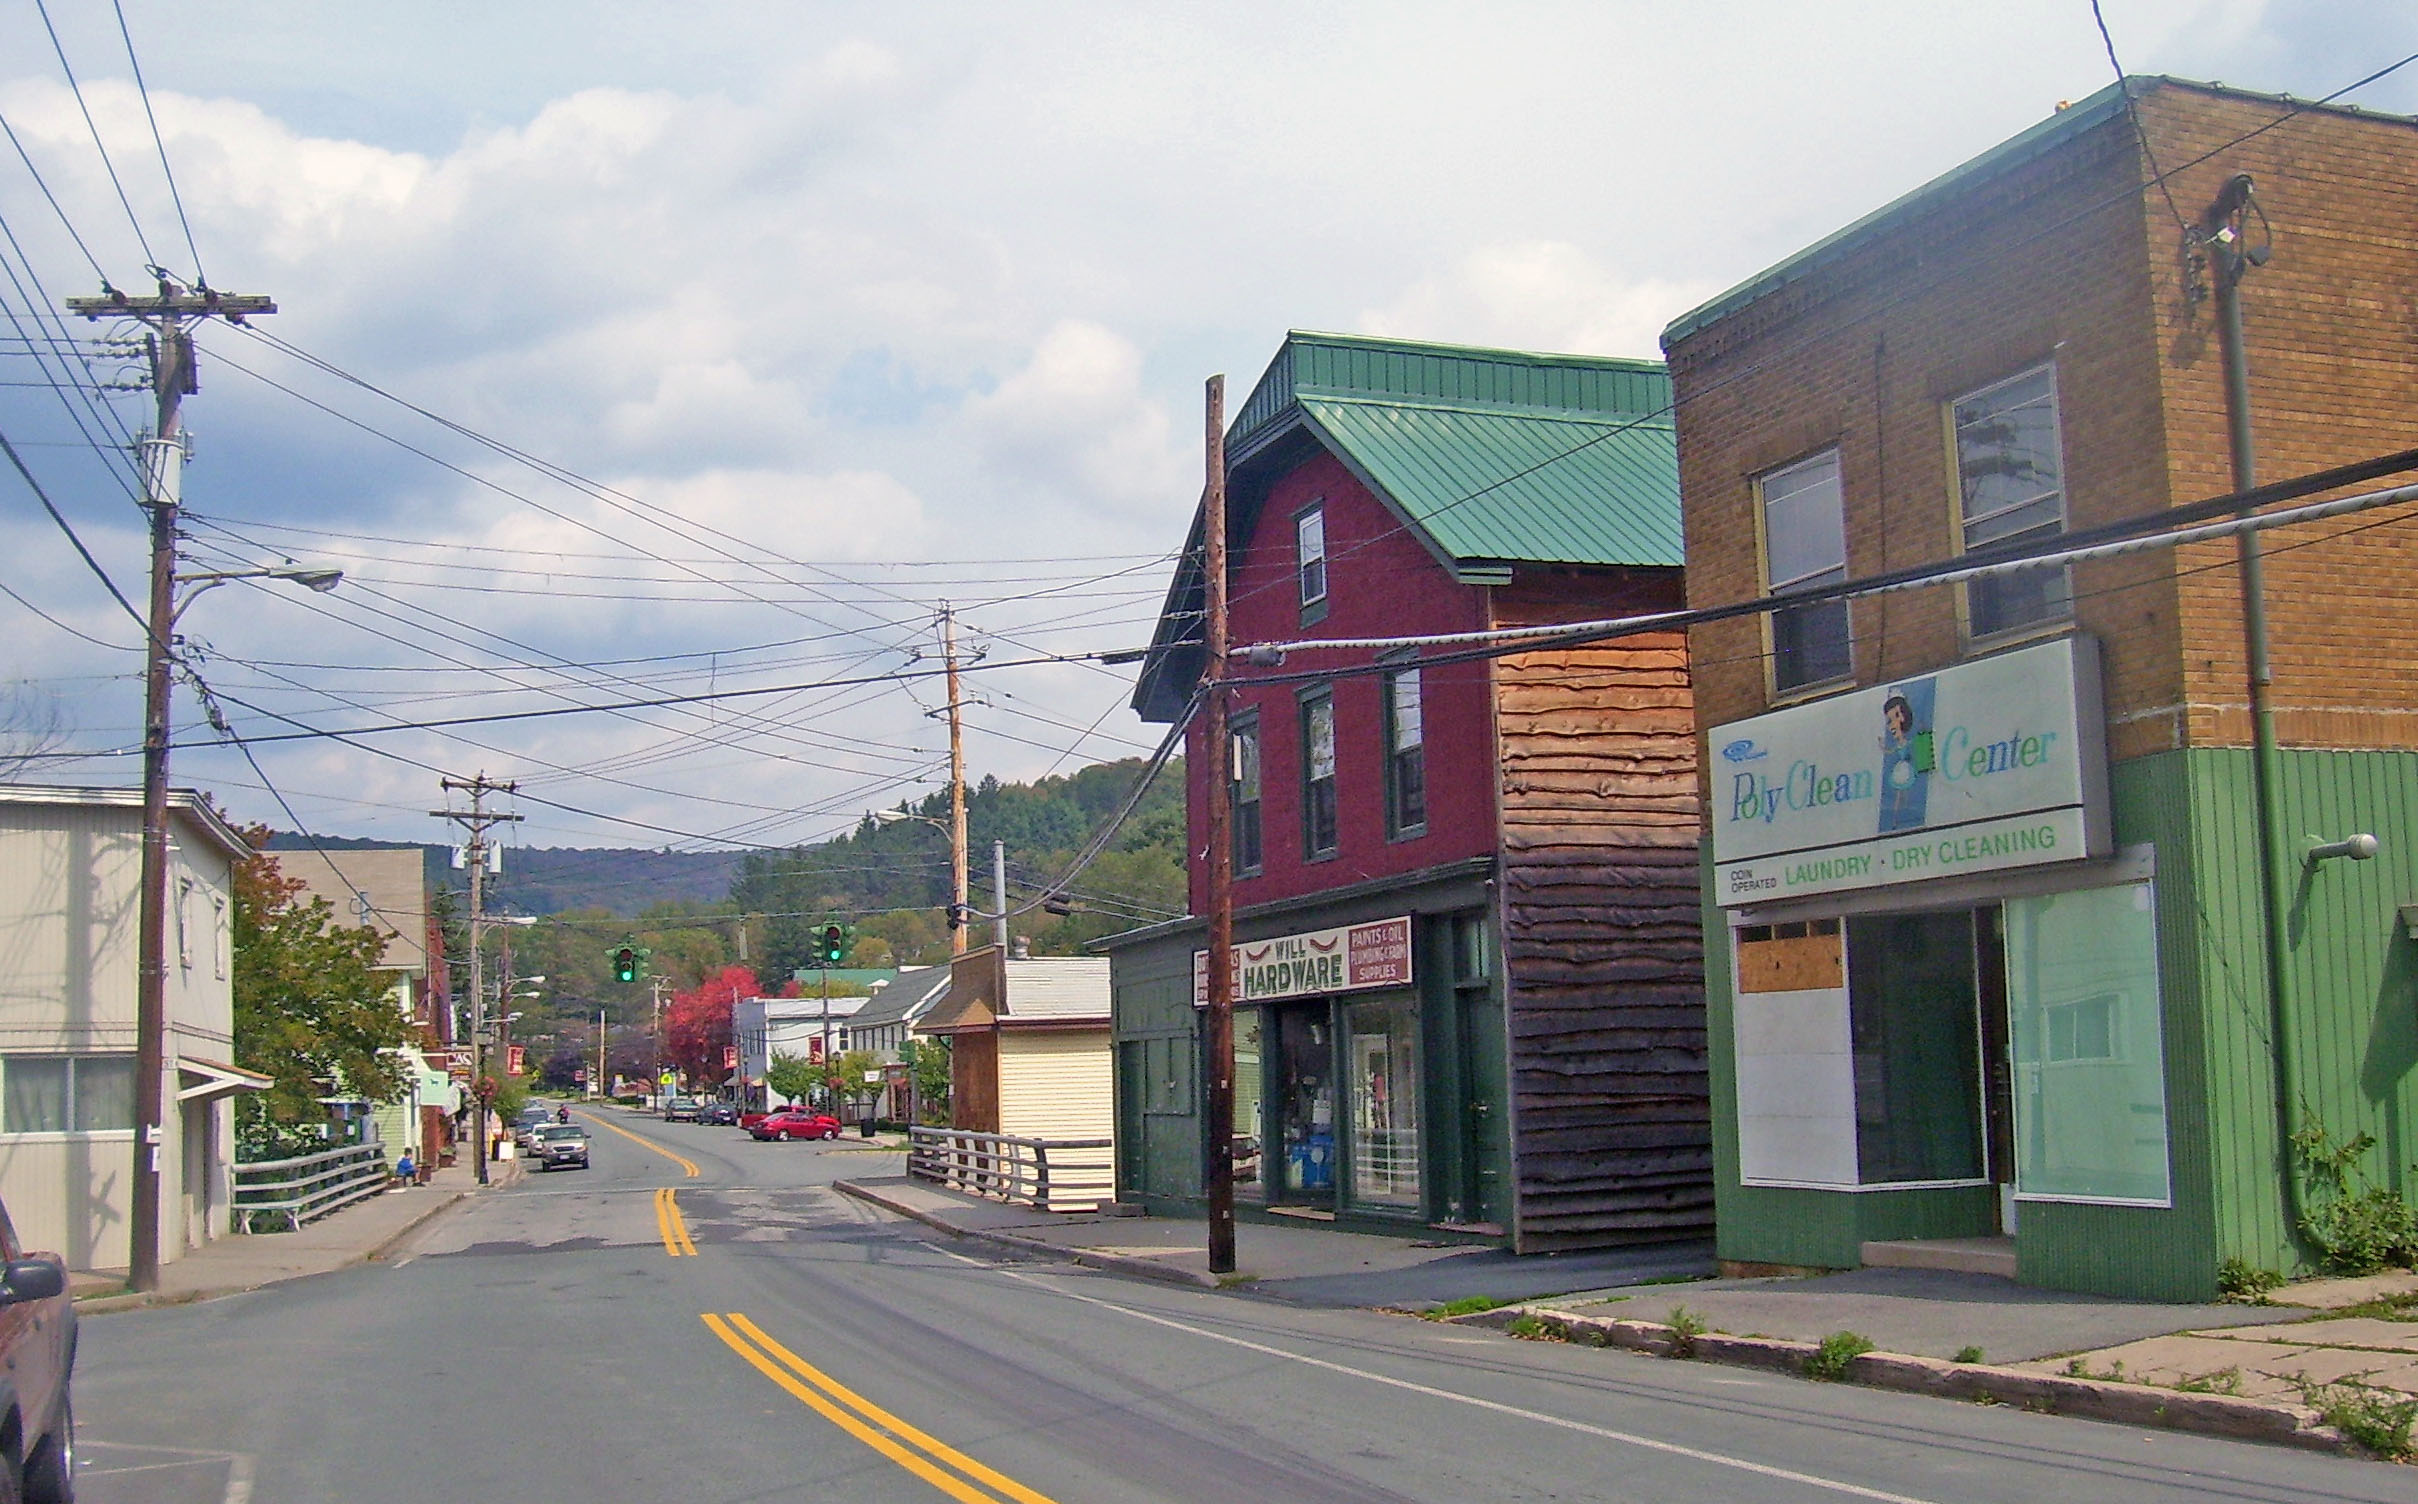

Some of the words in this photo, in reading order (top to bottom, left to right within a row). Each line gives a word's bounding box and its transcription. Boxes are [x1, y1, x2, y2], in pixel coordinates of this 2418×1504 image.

[1941, 725, 2057, 781] Center
[1785, 855, 1871, 886] LAUNDRY
[1893, 843, 1931, 872] DRY
[1939, 825, 2056, 867] CLEANING
[1730, 869, 1753, 881] COIN
[1731, 877, 1777, 893] OPERATED
[1351, 928, 1382, 948] PAINTS
[1388, 924, 1404, 943] OIL
[1275, 938, 1306, 961] WILL
[1244, 954, 1343, 997] HARDWARE
[1359, 963, 1397, 981] SUPPLIES
